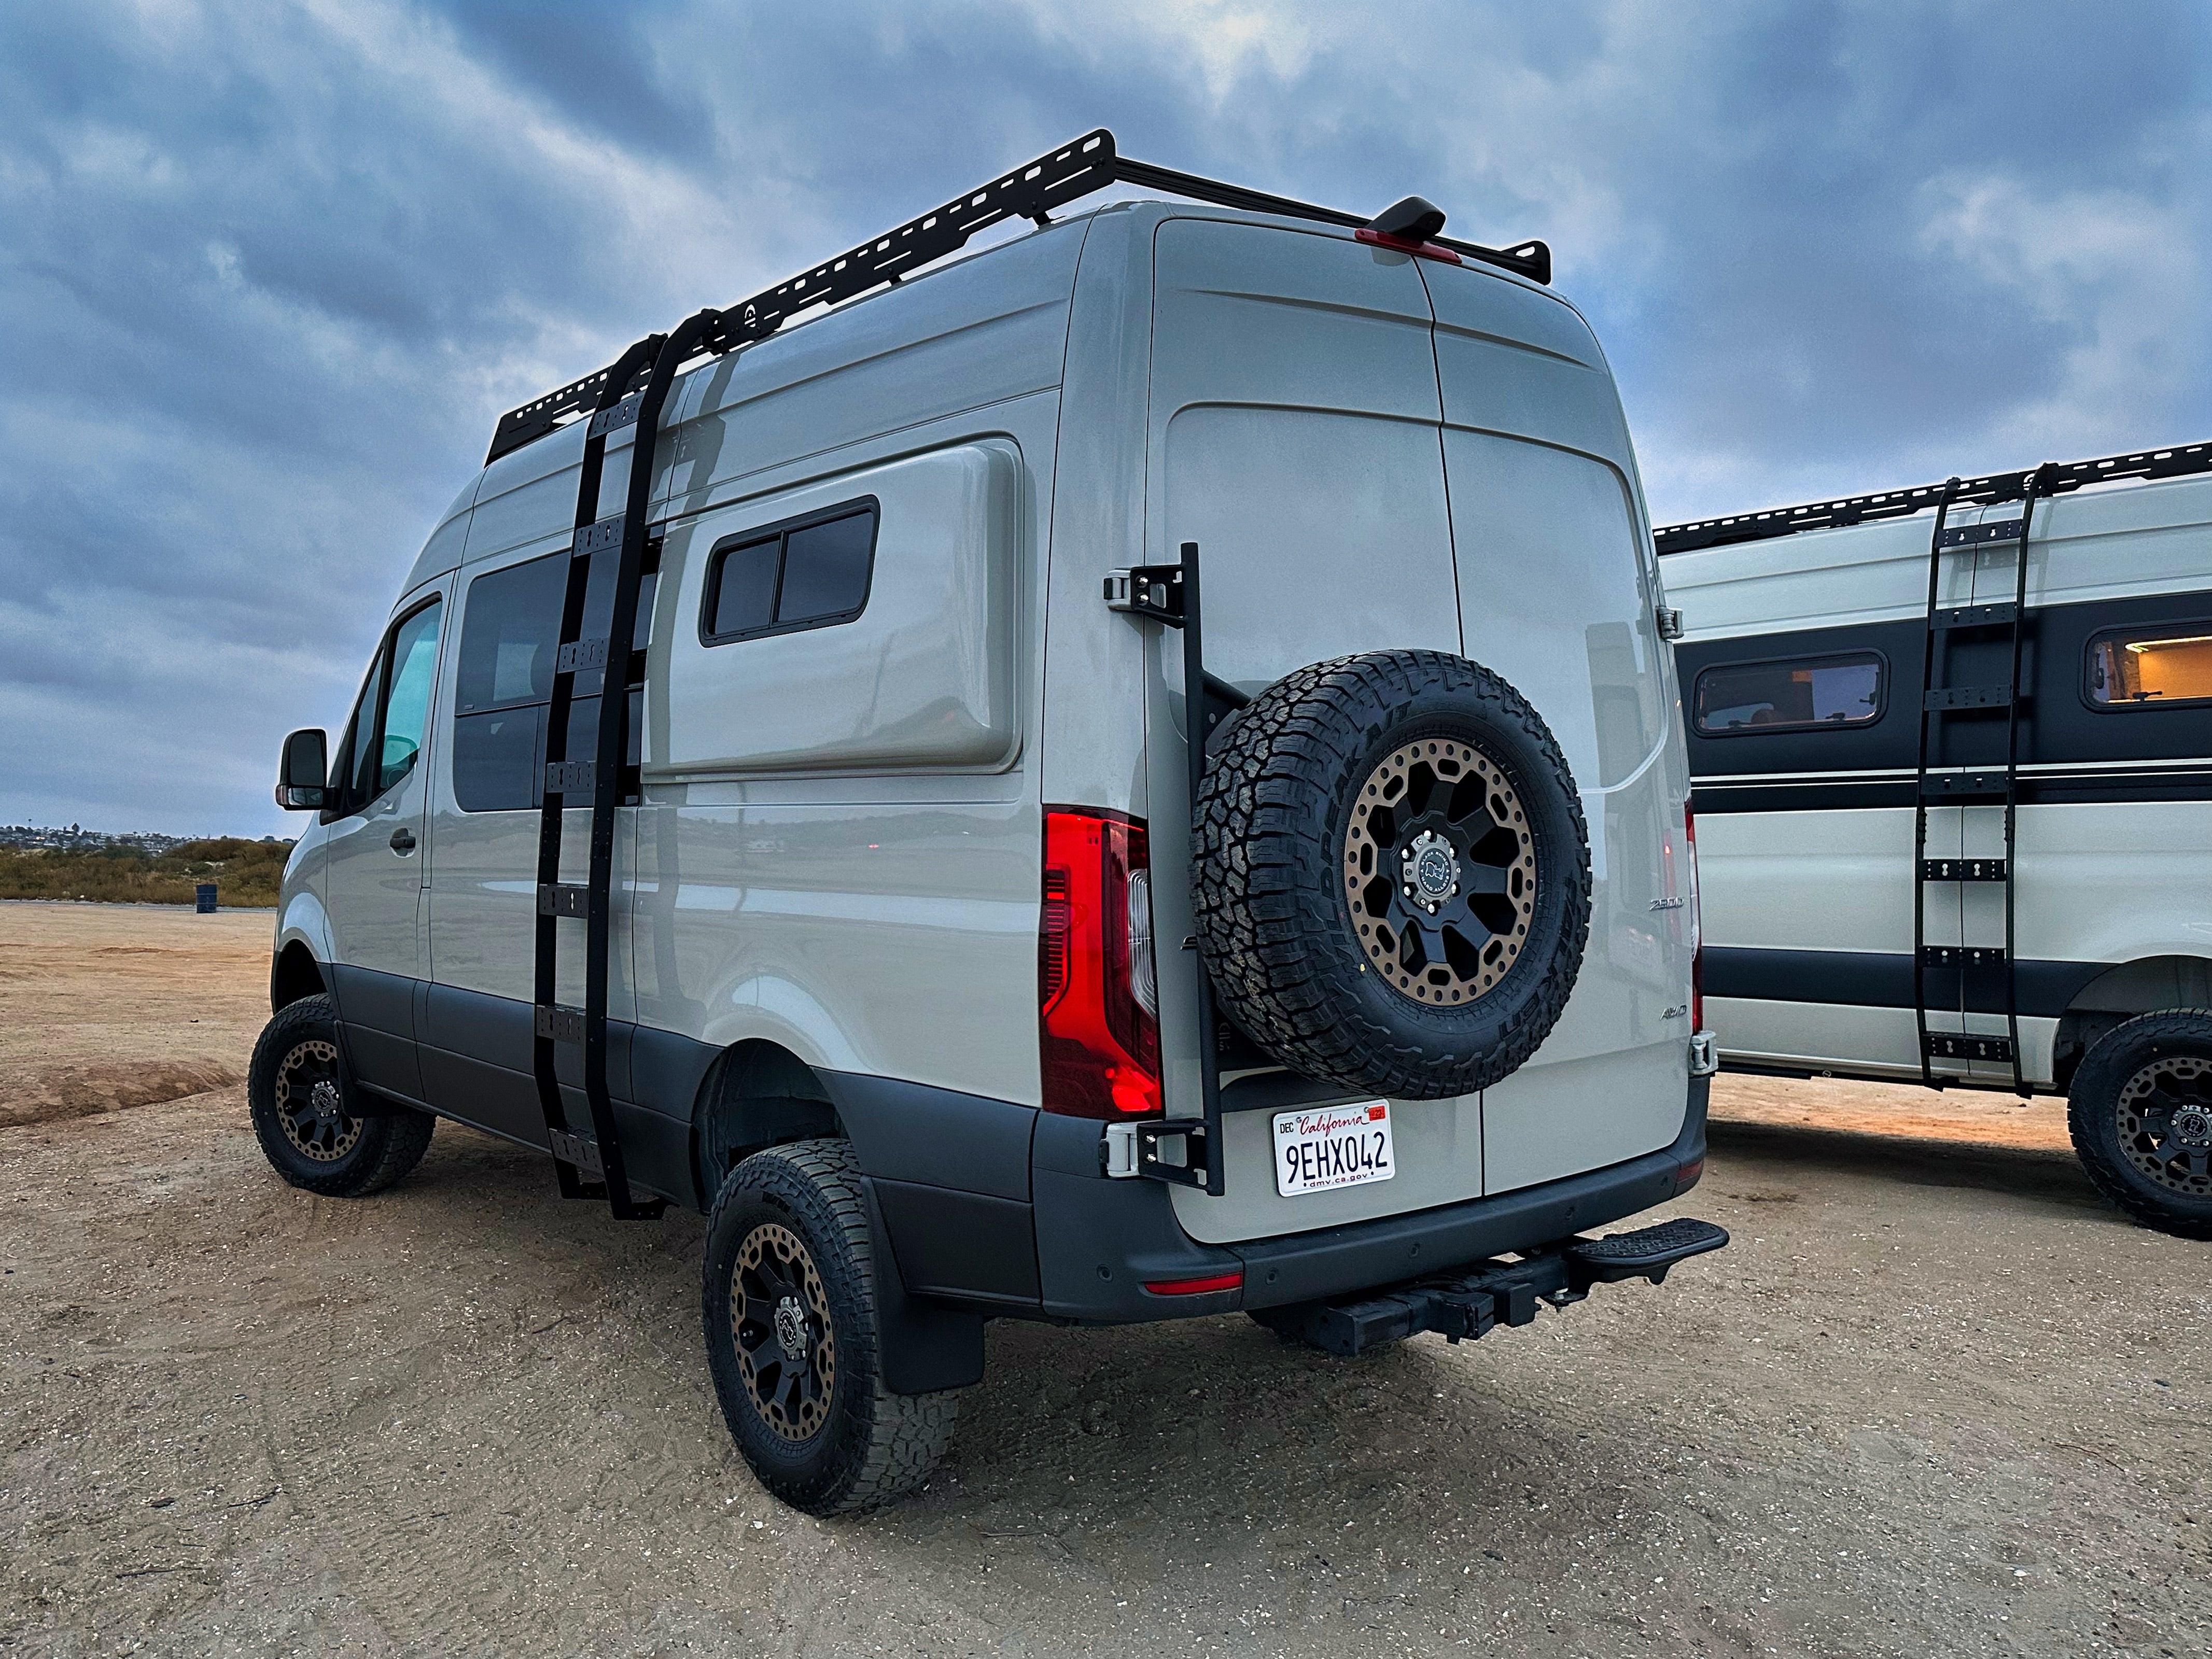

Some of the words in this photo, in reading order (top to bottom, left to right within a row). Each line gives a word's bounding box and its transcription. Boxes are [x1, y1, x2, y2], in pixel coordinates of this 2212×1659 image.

[1280, 1122, 1294, 1133] DEC
[1300, 1113, 1369, 1137] California
[1286, 1131, 1388, 1184] 9EHX042
[1310, 1173, 1367, 1187] dmv.ca.gov
